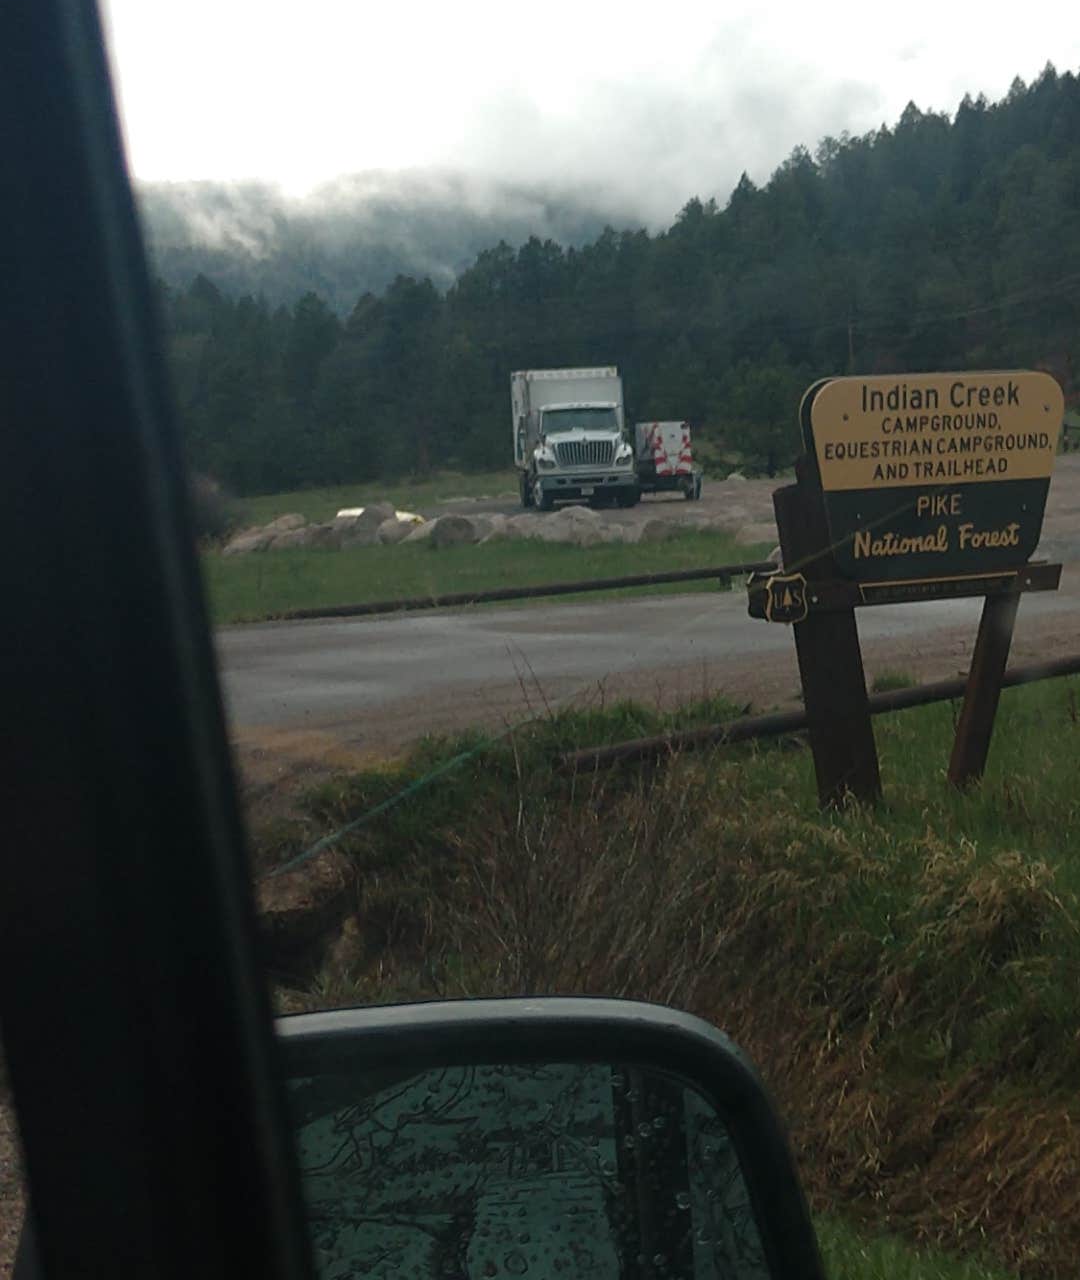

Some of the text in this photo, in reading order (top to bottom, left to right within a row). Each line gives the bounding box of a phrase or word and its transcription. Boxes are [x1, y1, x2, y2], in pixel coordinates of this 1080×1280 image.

[862, 381, 1020, 412] Indian Creek
[824, 438, 933, 460] EQUESTRIAN
[873, 457, 1008, 480] AND TRAILHEAD
[917, 493, 962, 517] PIKE
[853, 522, 1020, 559] National Forest
